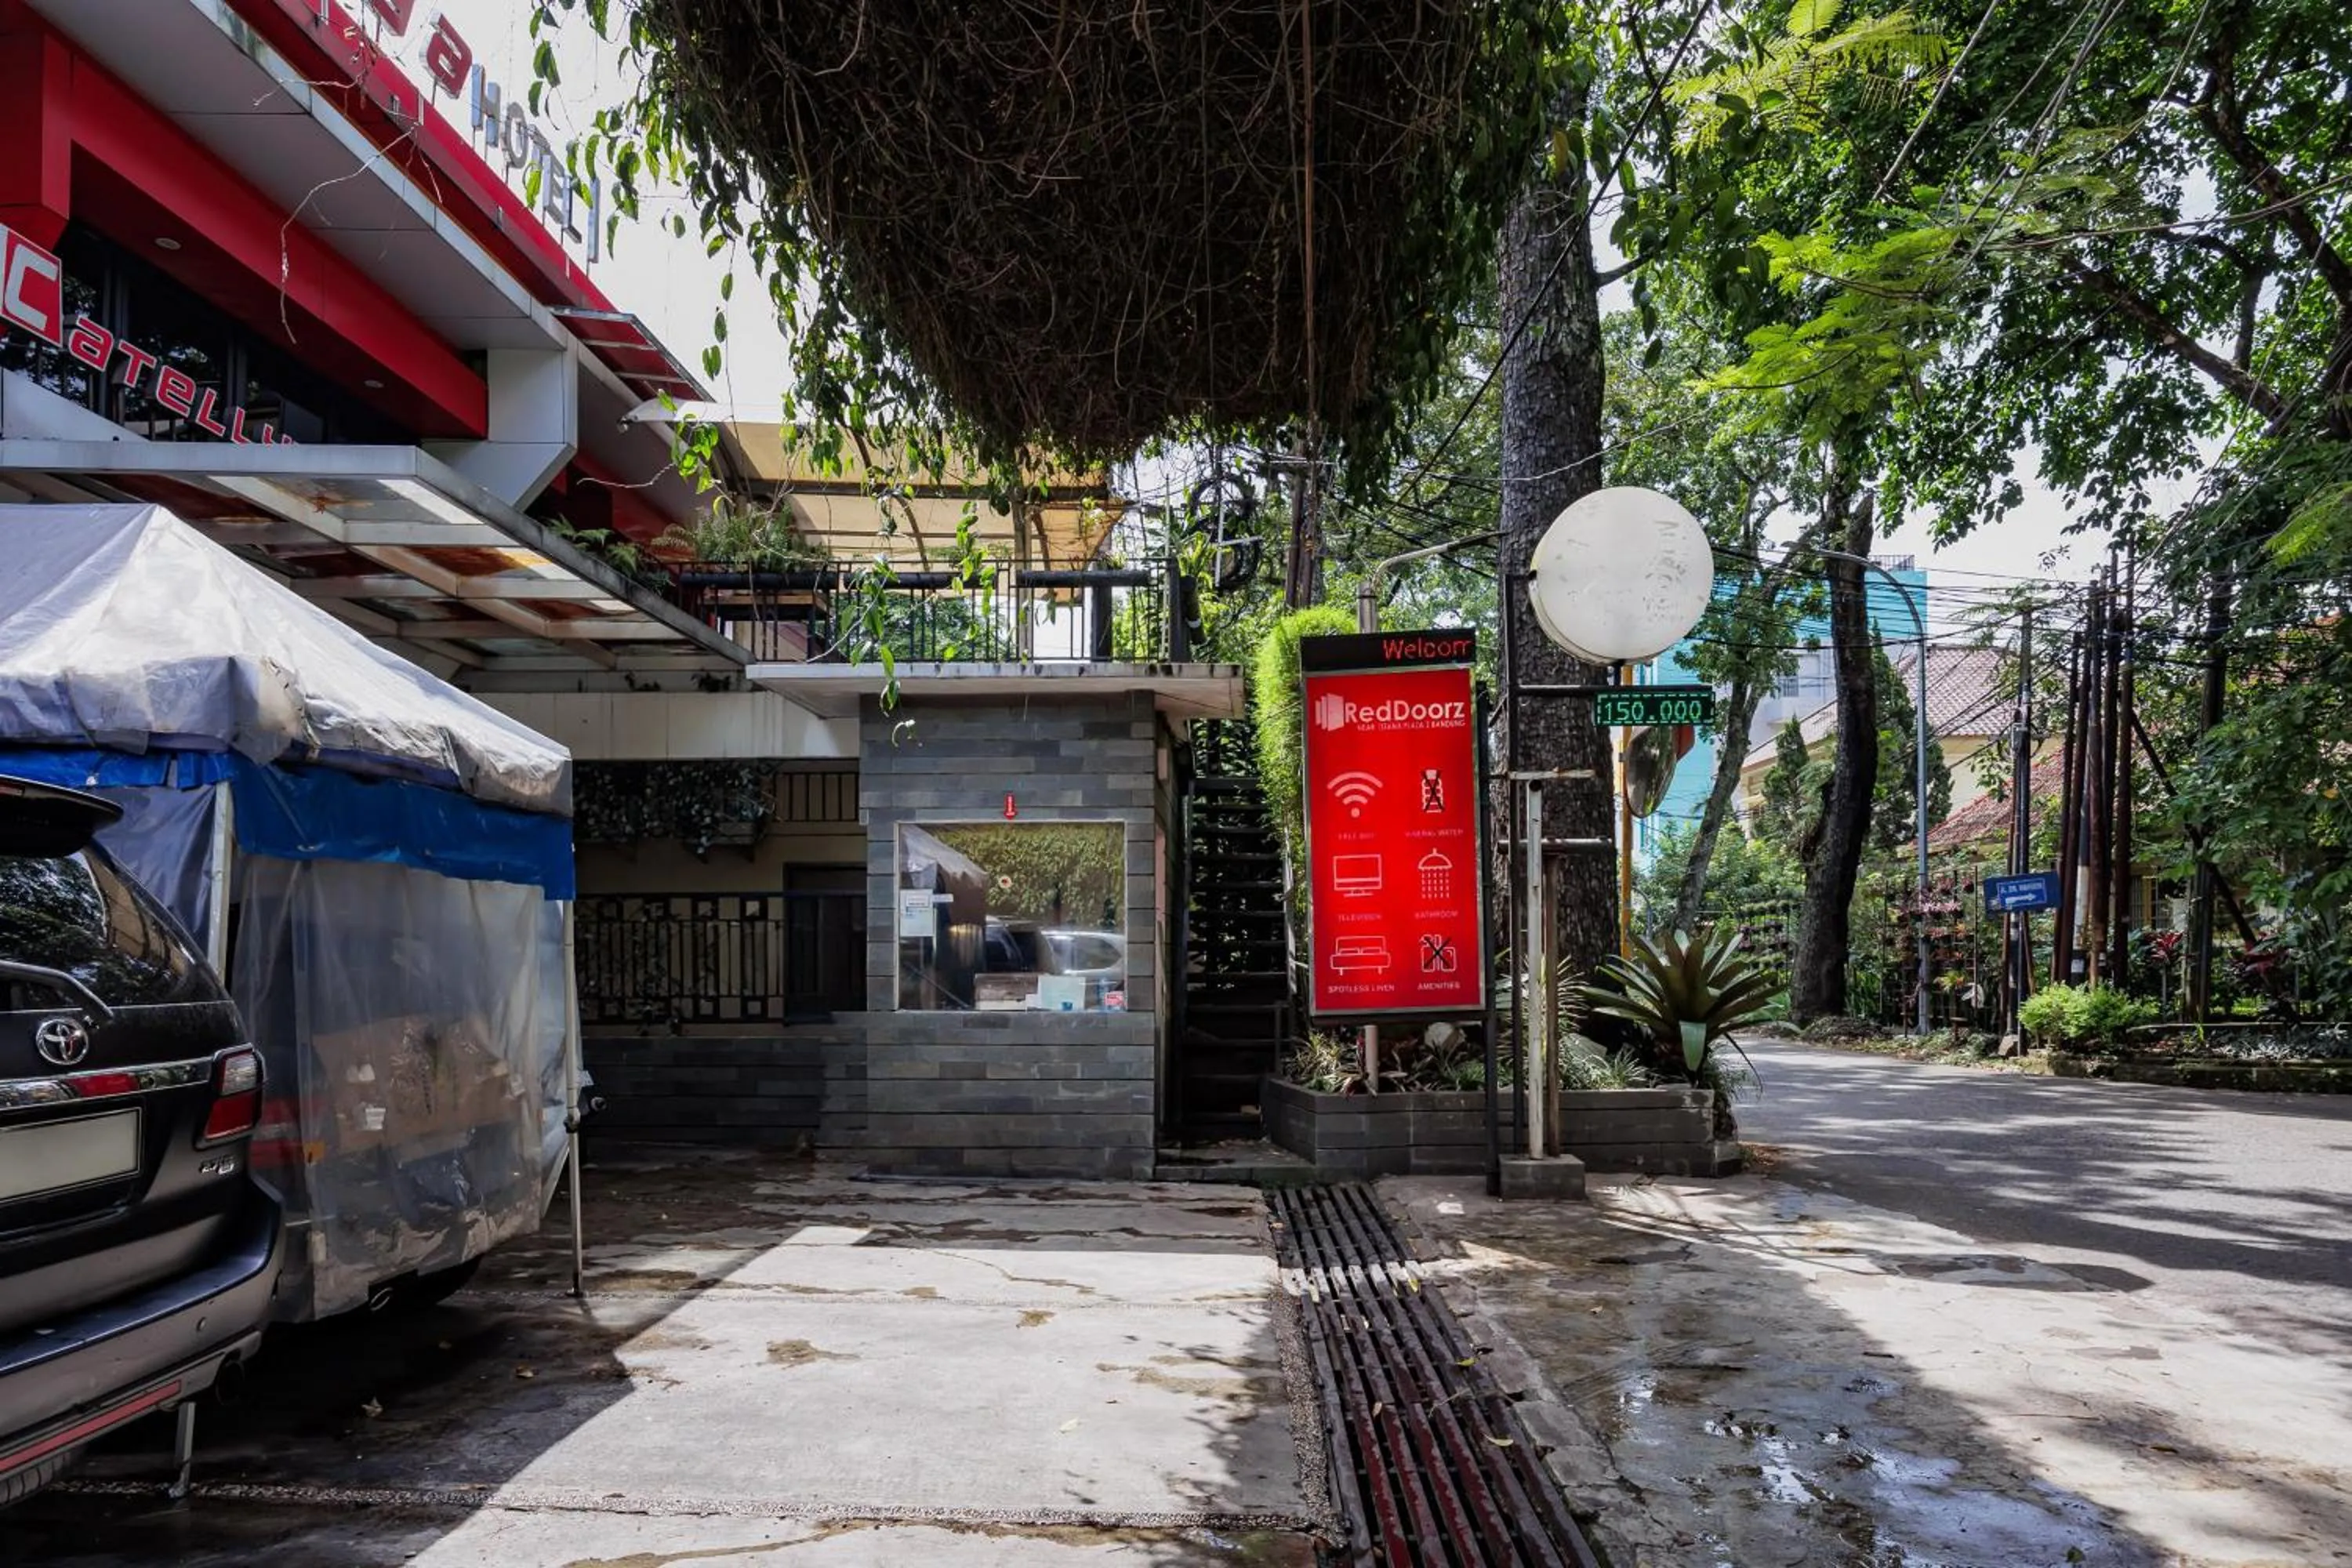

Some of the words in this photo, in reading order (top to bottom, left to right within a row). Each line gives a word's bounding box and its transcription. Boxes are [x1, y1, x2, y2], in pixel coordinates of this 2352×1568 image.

[1345, 699, 1465, 724] RedDoorz
[1604, 700, 1702, 721] 150.000
[1431, 719, 1466, 729] BANDUNG
[1327, 984, 1370, 993] SPOTLESS
[1417, 981, 1461, 991] AMENITIES
